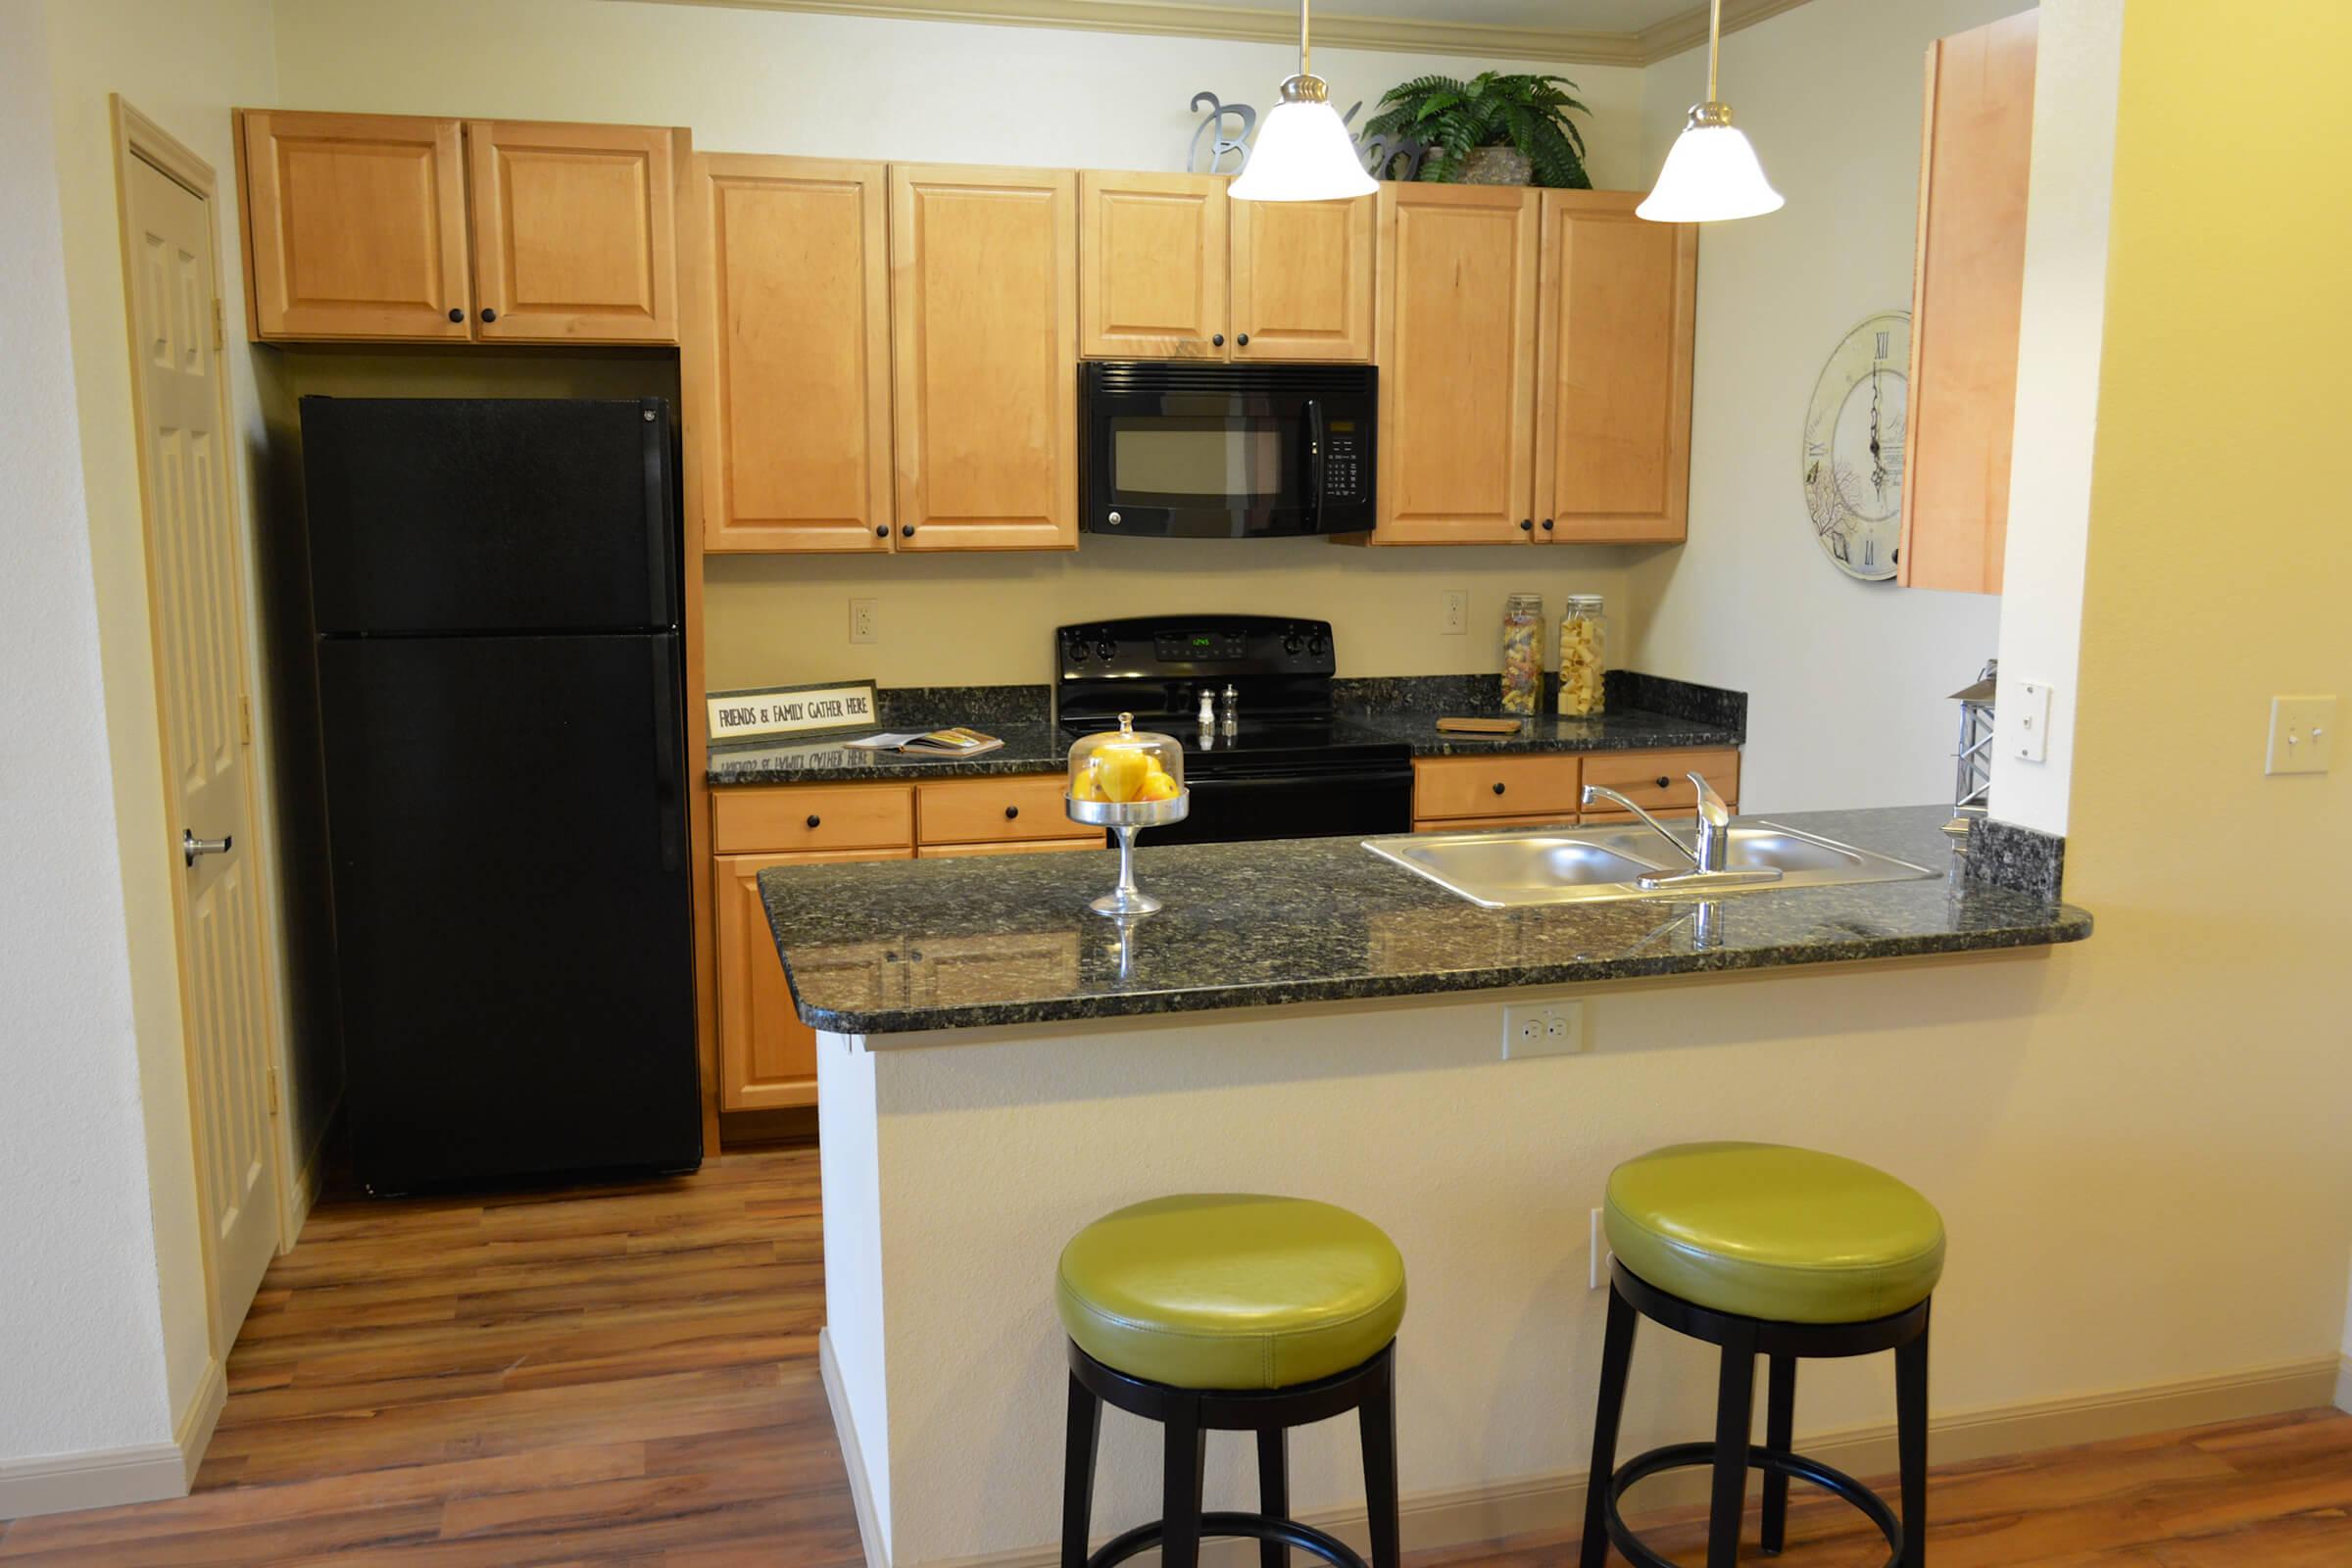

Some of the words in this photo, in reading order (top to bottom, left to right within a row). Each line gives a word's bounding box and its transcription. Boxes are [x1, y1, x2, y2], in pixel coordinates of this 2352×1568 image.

[1874, 330, 1890, 360] XII
[718, 707, 757, 728] FRIENDS
[760, 709, 769, 723] &
[772, 703, 804, 722] FAMILY
[808, 700, 844, 719] GATHER
[846, 697, 869, 714] HERE
